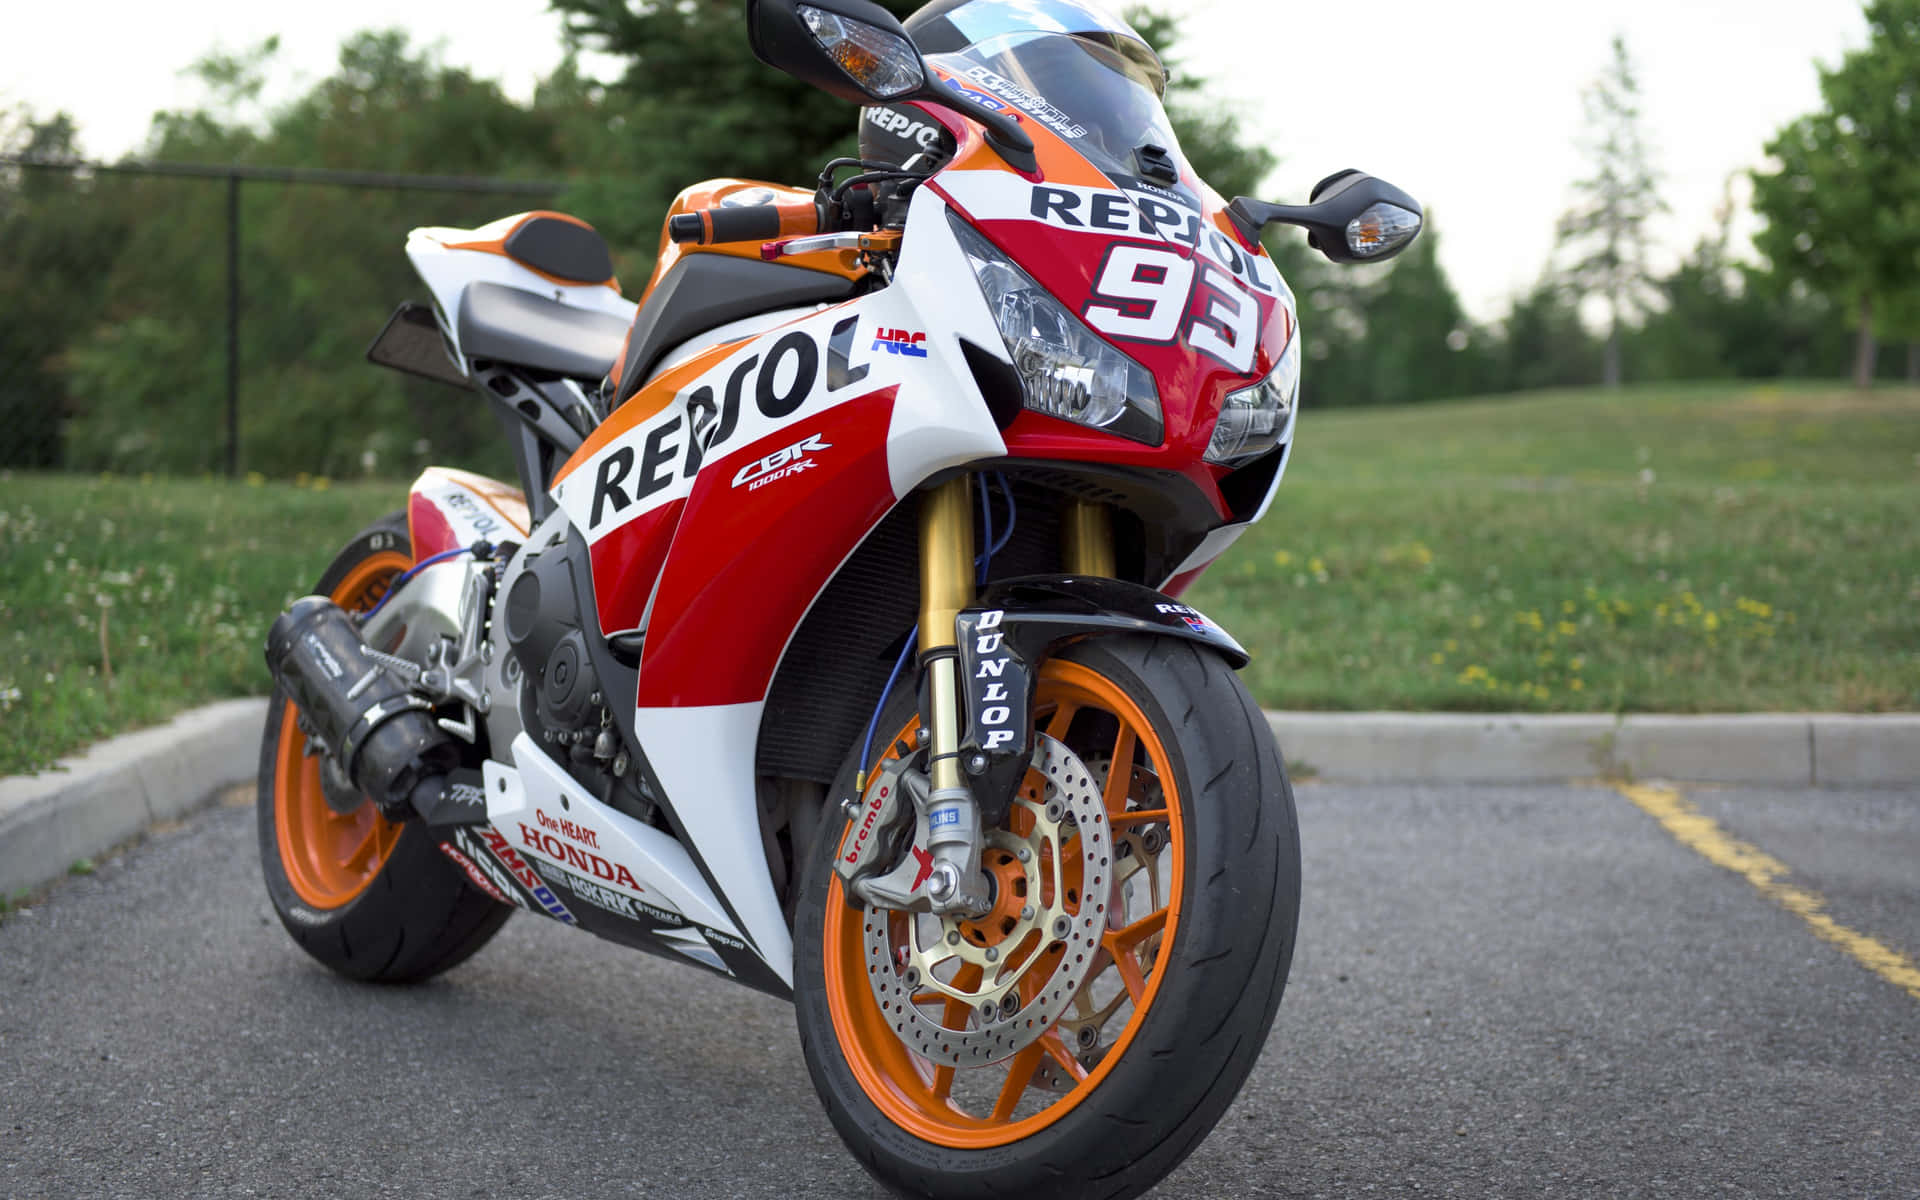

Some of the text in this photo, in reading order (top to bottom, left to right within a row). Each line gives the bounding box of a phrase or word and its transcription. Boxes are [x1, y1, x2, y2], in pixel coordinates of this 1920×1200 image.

[866, 106, 939, 148] REPSO
[1136, 181, 1186, 204] HONDA
[1031, 185, 1273, 292] REPSOL
[871, 327, 928, 358] HRC
[1080, 240, 1263, 378] 93
[589, 313, 870, 530] REPSOL
[731, 432, 833, 488] CBR
[976, 610, 1015, 749] DUNLOP
[536, 808, 559, 832] One
[845, 786, 889, 864] brembo
[517, 821, 645, 893] HONDA
